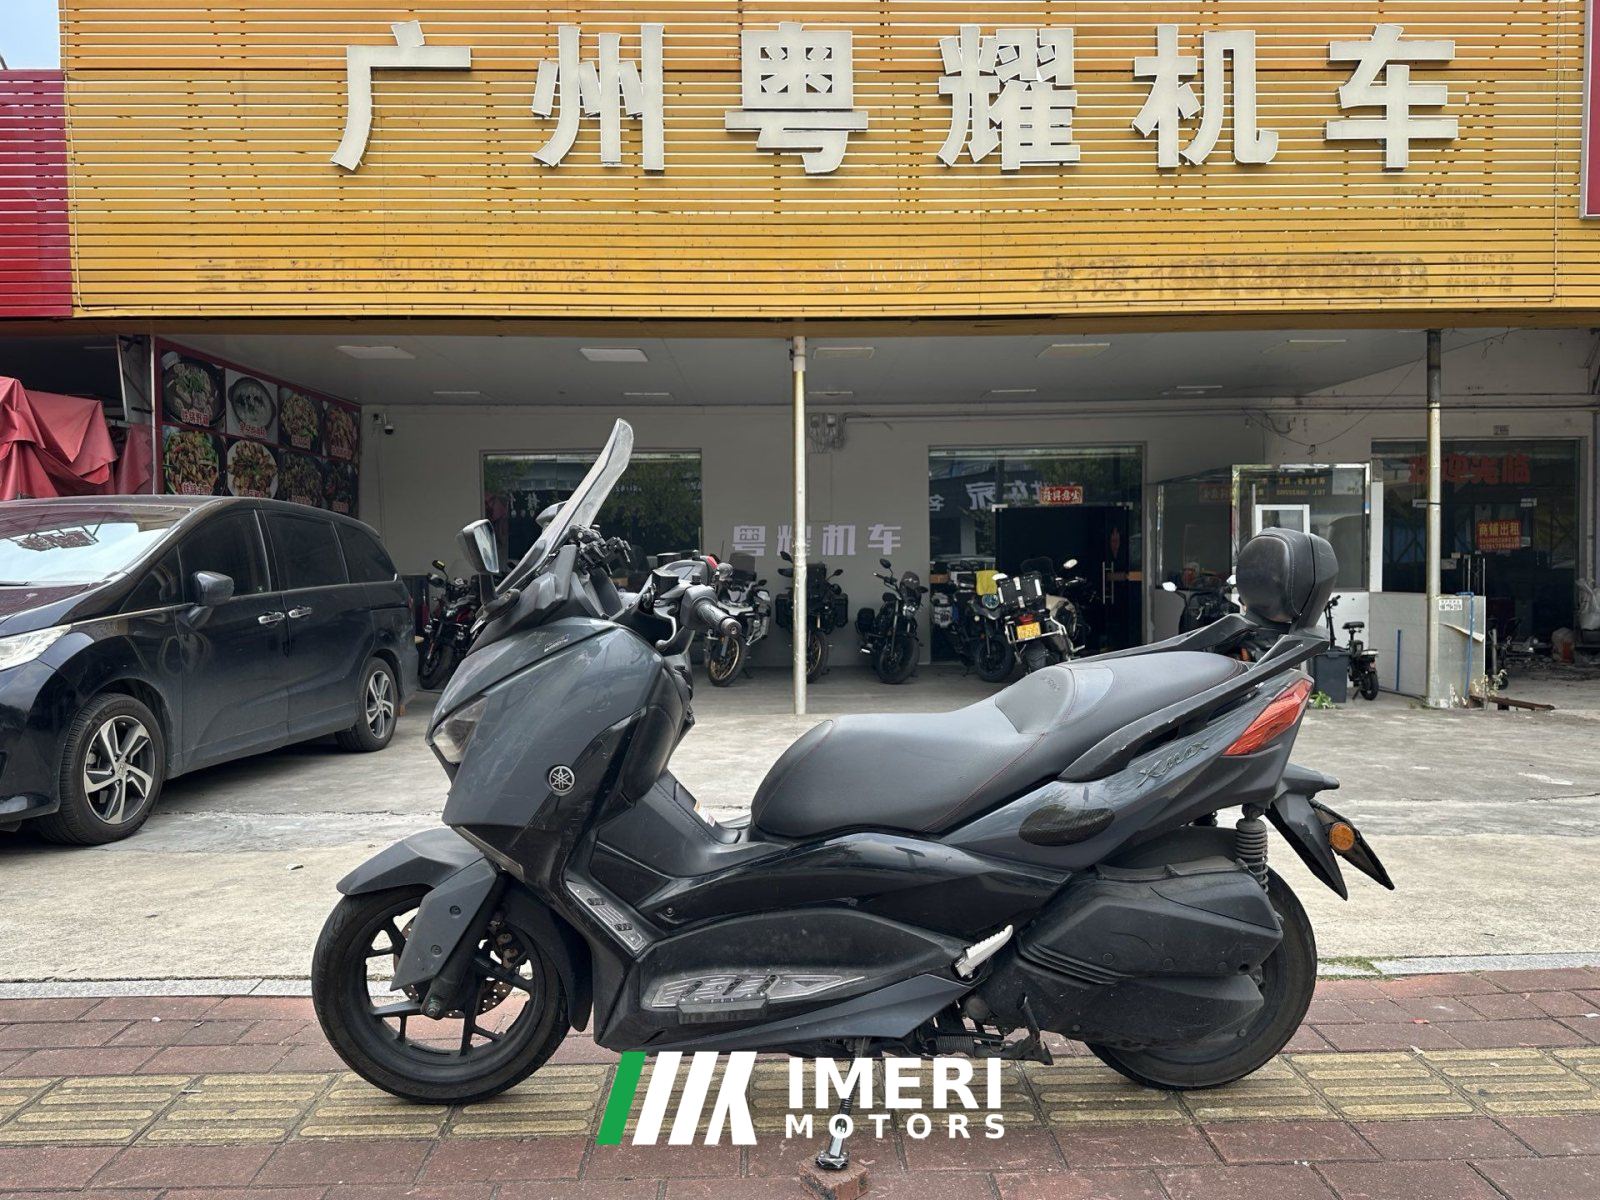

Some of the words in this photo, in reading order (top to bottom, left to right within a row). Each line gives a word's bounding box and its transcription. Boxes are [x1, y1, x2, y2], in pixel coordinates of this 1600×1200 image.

[331, 20, 1459, 173] 广州粤耀机车
